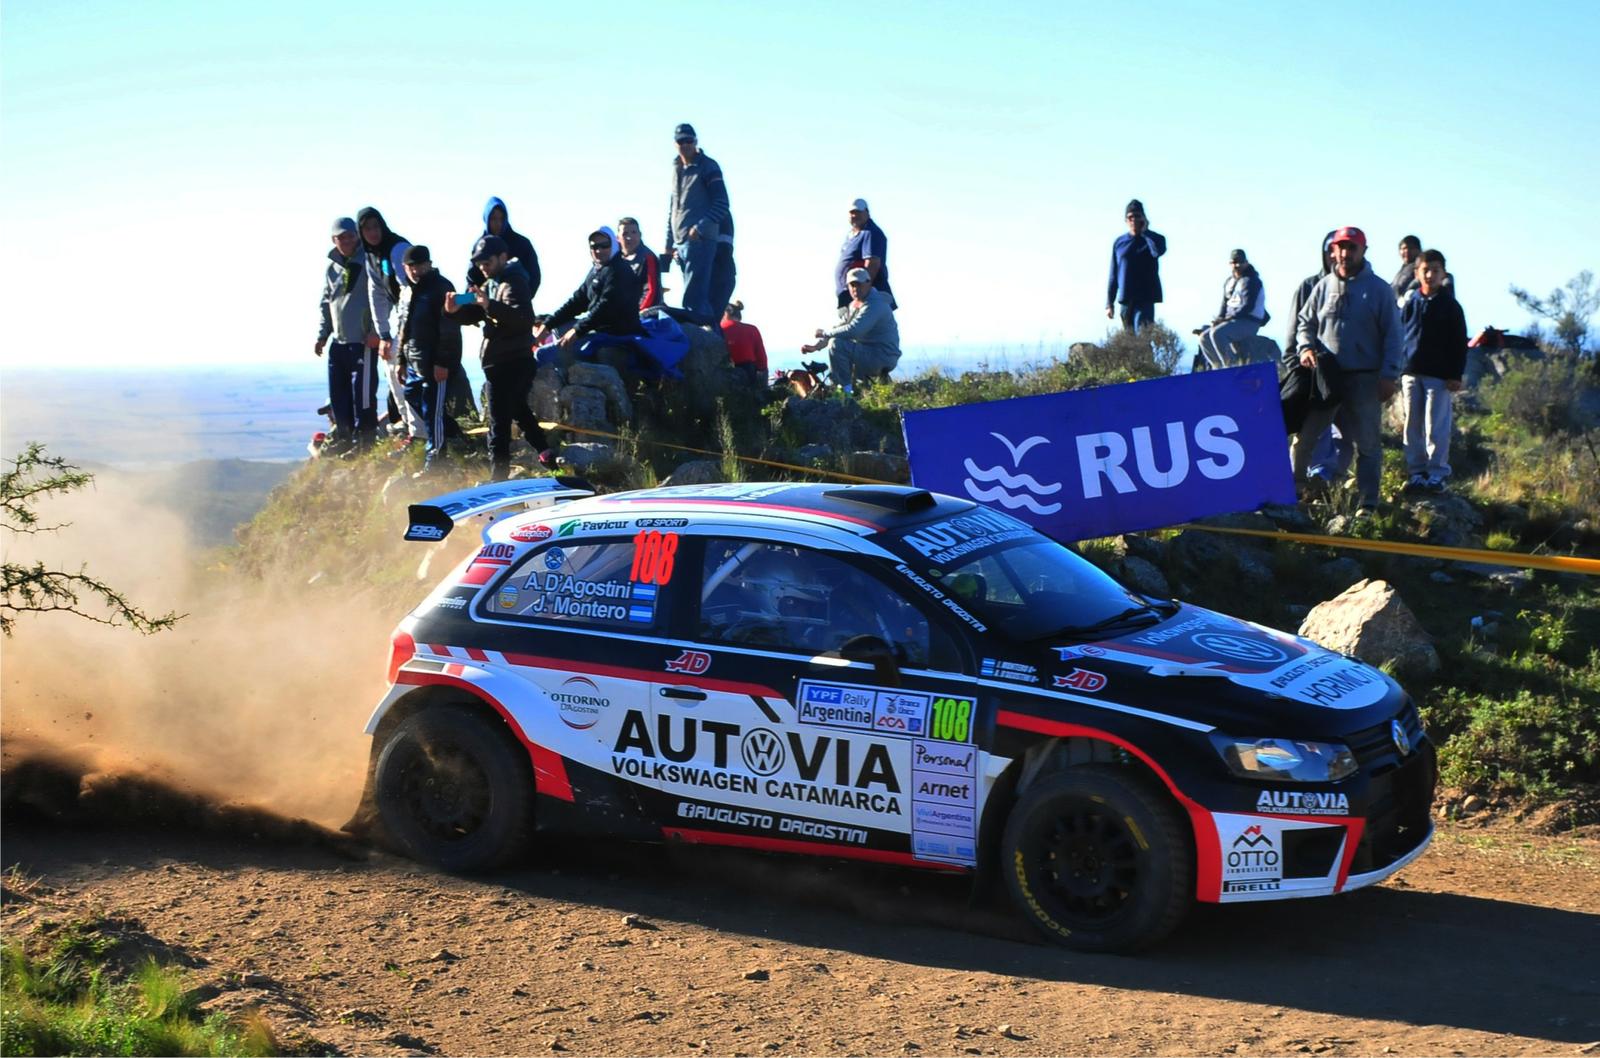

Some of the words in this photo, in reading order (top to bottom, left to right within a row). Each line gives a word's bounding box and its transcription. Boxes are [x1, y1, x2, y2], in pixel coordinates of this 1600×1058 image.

[1076, 415, 1245, 499] RUS
[582, 520, 628, 531] Favicur
[638, 519, 654, 527] VIP
[654, 519, 687, 527] SPORT
[629, 530, 678, 585] 108
[525, 571, 541, 591] A.
[547, 573, 632, 599] D'Agostini
[533, 595, 548, 612] J.
[553, 596, 627, 620] Montero
[551, 693, 610, 707] OTTORINO
[810, 689, 840, 700] YPF
[843, 692, 870, 708] Rally
[802, 702, 871, 723] Argentina
[932, 698, 971, 742] 108
[915, 744, 973, 772] Personal
[611, 755, 758, 795] VOLKSWAGEN
[765, 779, 902, 816] CATAMARCA
[918, 782, 970, 799] Arnet
[694, 804, 773, 829] AUGUSTO
[779, 819, 868, 844] DAGOSTINI
[1227, 850, 1279, 867] OTTO
[1223, 877, 1281, 893] PIRELLI
